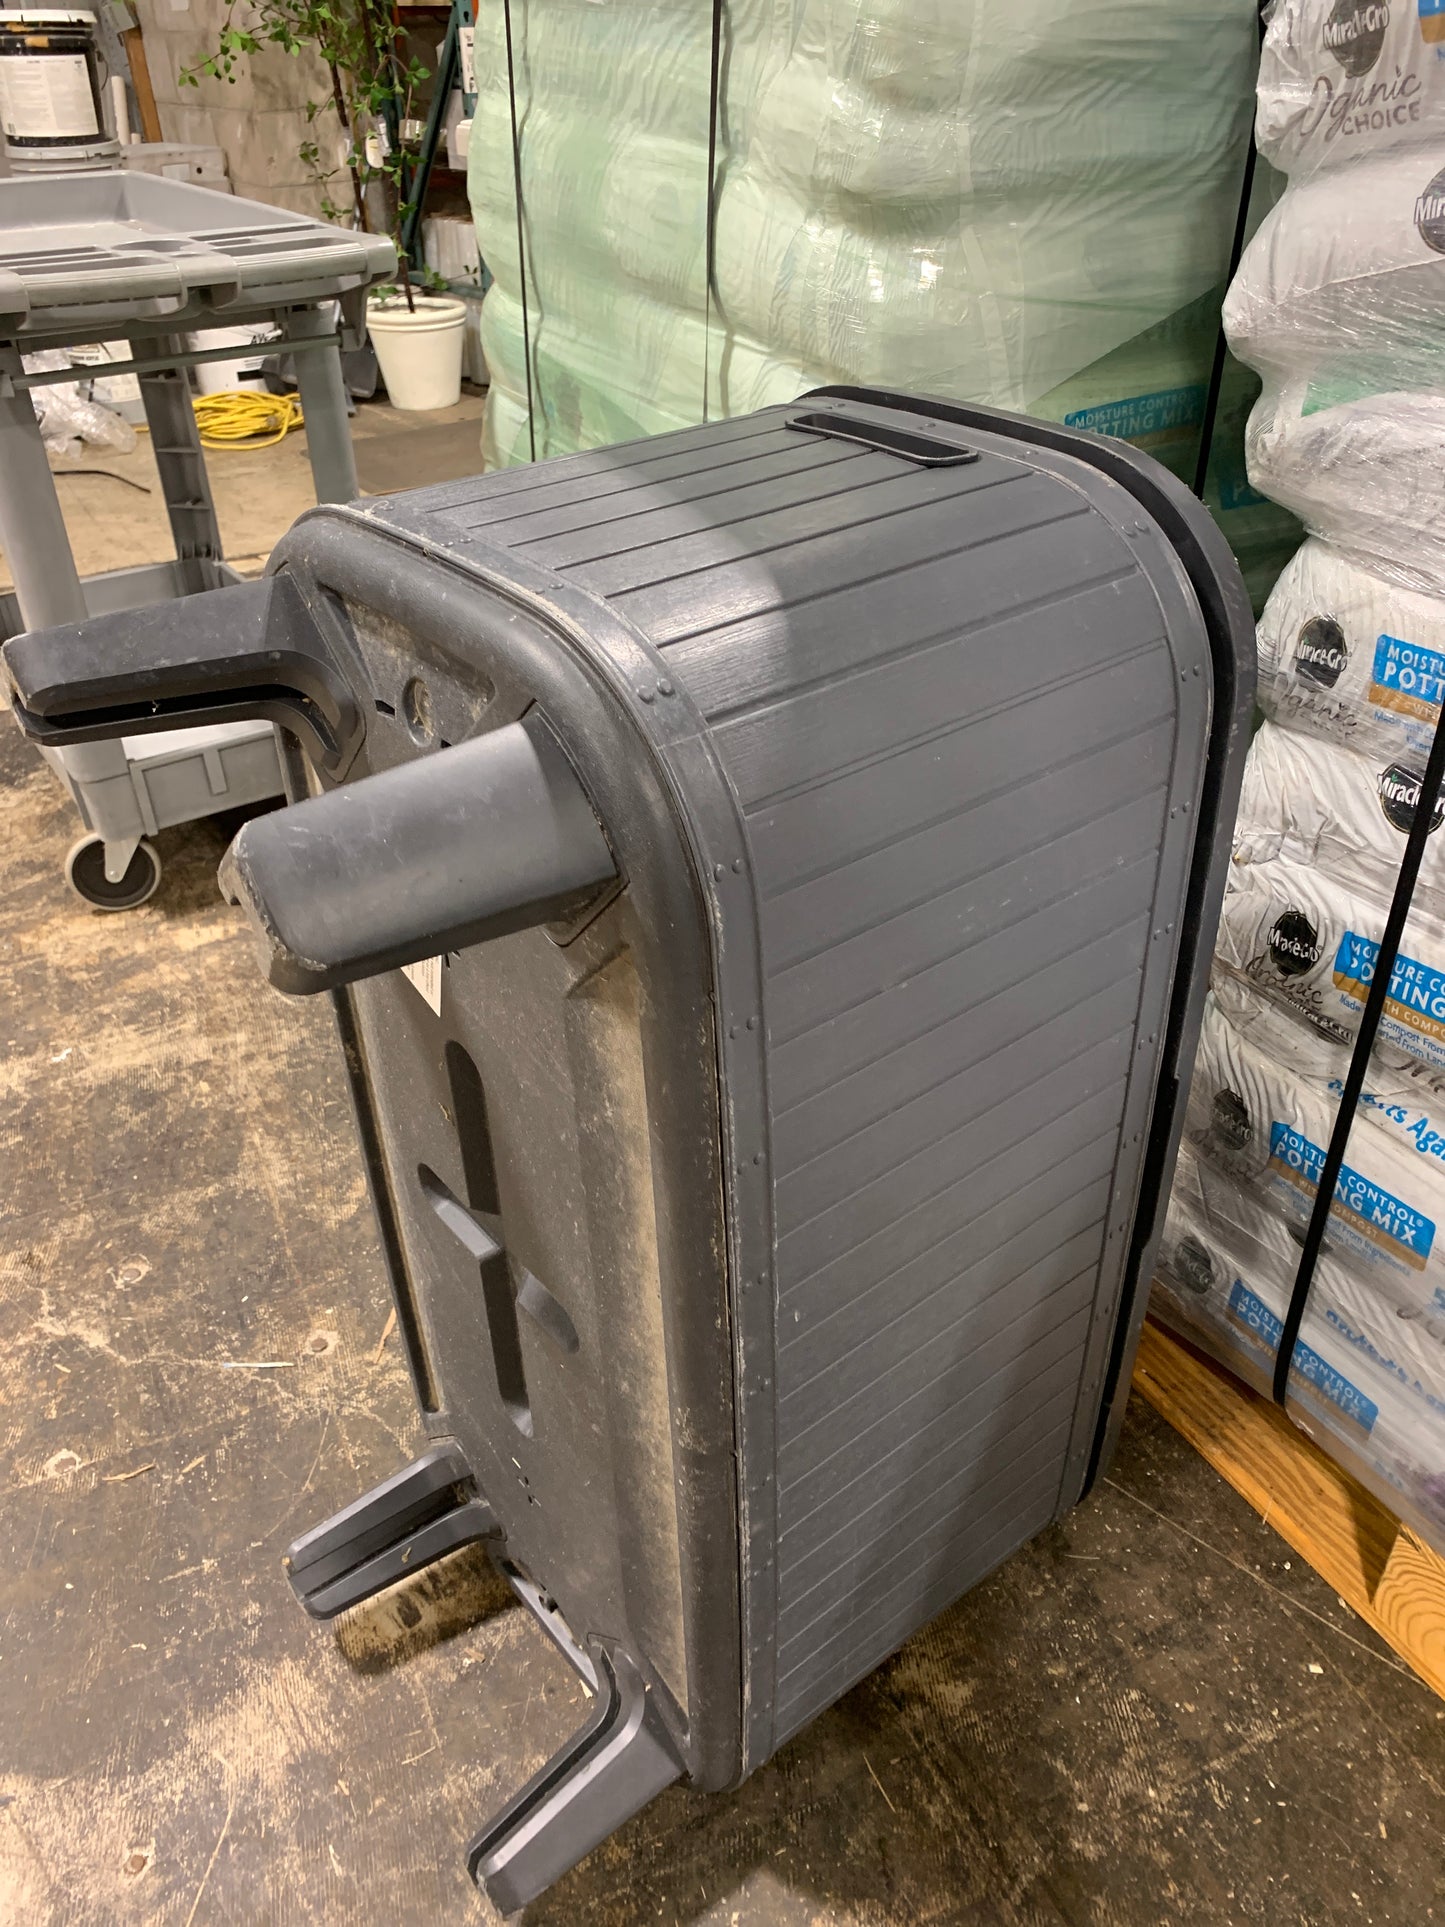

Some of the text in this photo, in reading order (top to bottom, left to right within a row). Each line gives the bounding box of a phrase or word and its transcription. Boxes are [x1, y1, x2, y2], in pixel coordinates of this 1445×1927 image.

[1342, 101, 1420, 135] CHOICE
[1074, 403, 1135, 428] MOISTURE
[1162, 405, 1195, 425] MIX
[1371, 1206, 1416, 1246] MIX
